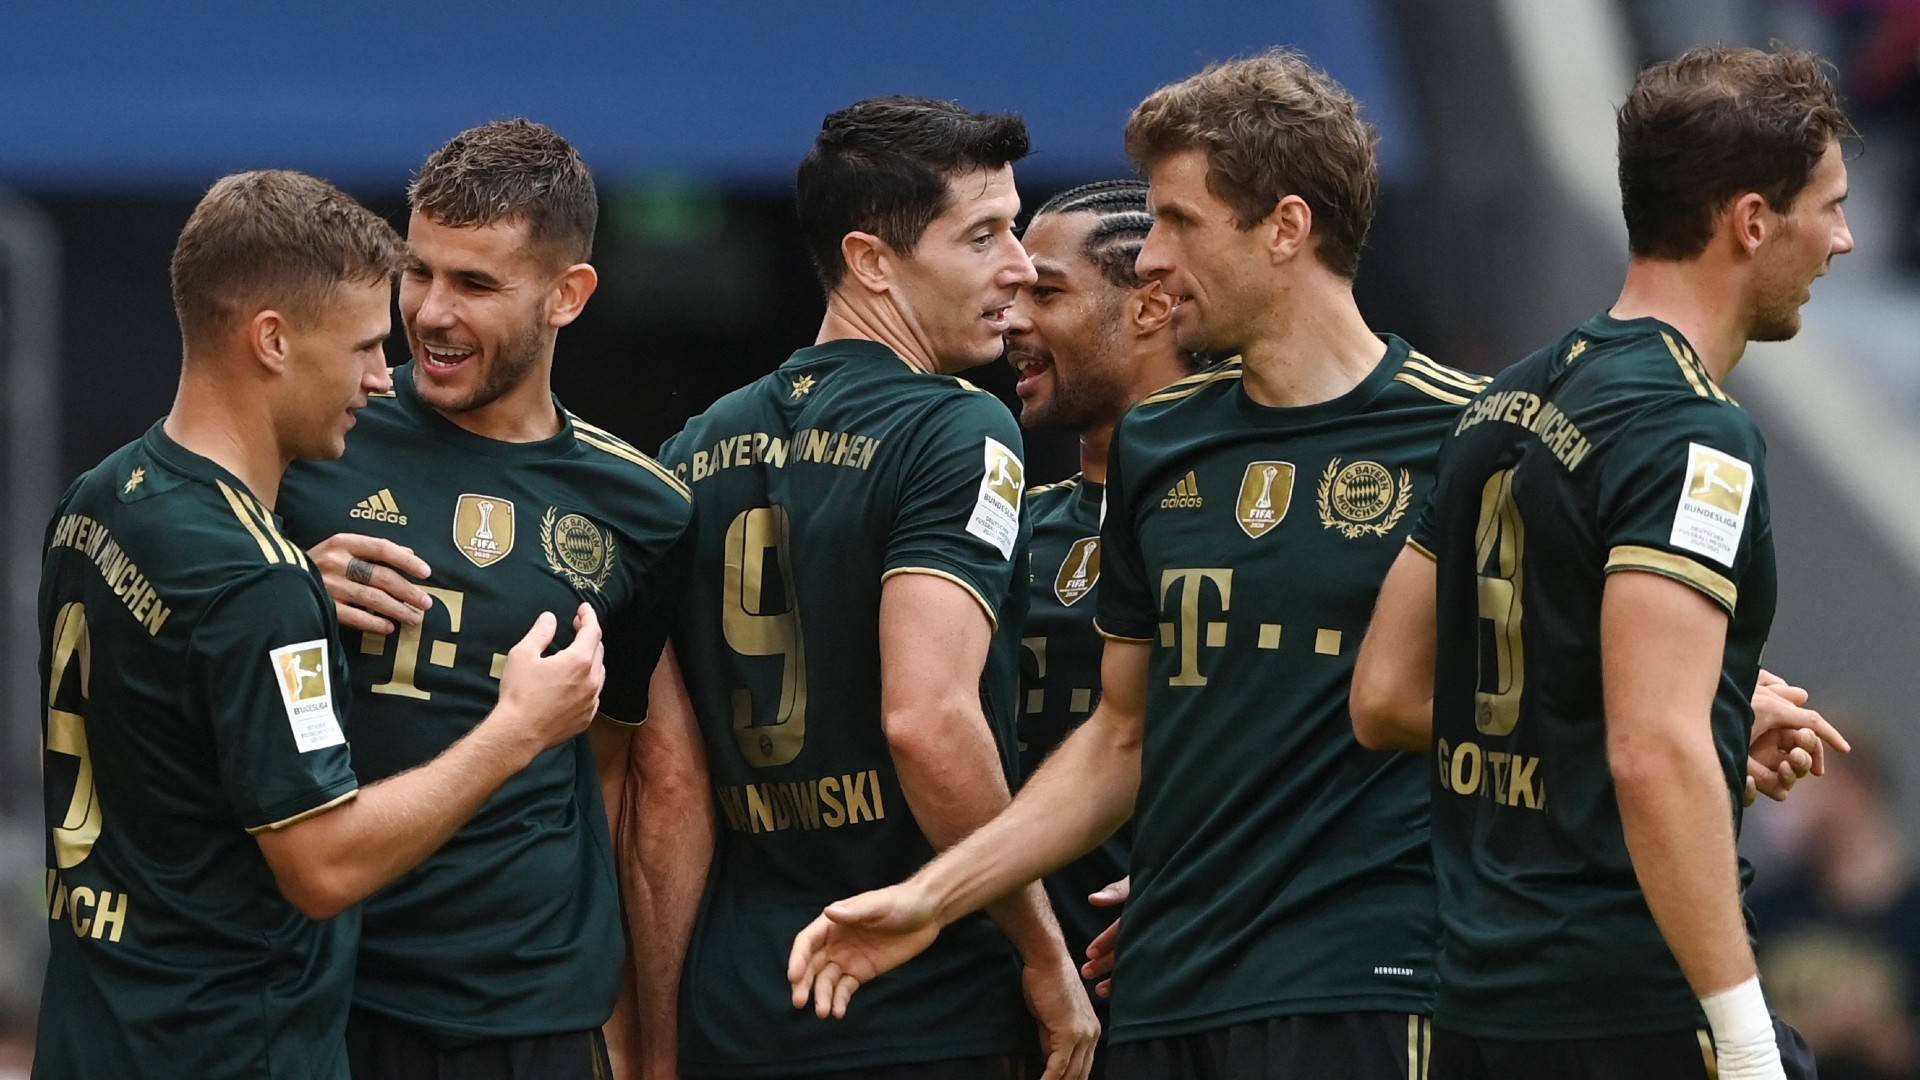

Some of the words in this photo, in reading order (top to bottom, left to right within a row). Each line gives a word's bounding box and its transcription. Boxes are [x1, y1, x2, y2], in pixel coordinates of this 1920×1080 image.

[693, 432, 790, 482] BAYERN
[1340, 471, 1354, 486] FC
[1354, 466, 1390, 491] BAYERN
[983, 493, 1017, 524] BUNDESLIGA
[1161, 495, 1203, 509] adidas
[350, 507, 408, 526] adidas
[1249, 509, 1272, 519] FIFA
[1684, 503, 1737, 530] BUNDESLIGA
[470, 537, 497, 550] FIFA
[570, 519, 600, 548] BAYERN
[1065, 579, 1087, 589] FIFA
[722, 504, 808, 768] 9
[1374, 966, 1414, 976] AEROREADY
